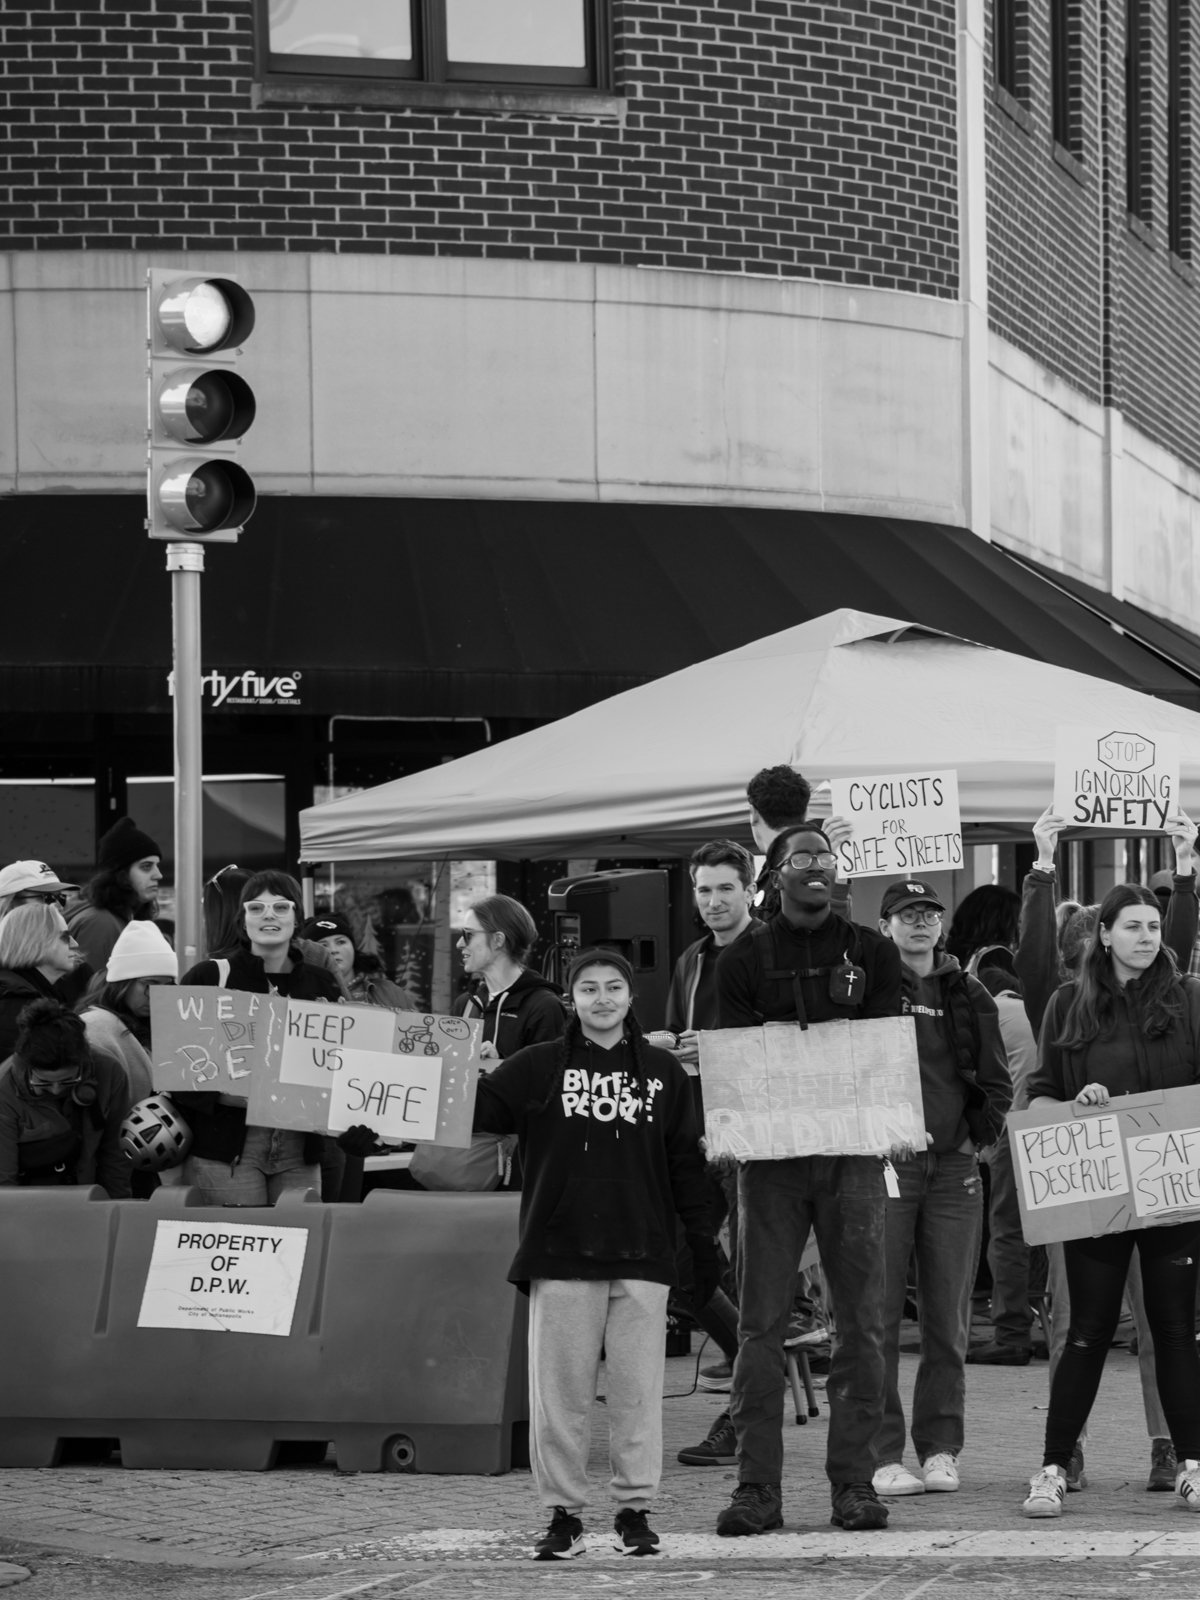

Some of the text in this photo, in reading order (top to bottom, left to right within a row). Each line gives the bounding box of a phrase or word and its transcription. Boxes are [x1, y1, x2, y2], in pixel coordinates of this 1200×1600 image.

[1104, 741, 1146, 762] STOP
[849, 777, 943, 811] CYCLISTS
[1074, 769, 1171, 799] IGNORING
[882, 818, 907, 834] FOR
[1073, 794, 1170, 829] SAFETY
[839, 833, 961, 872] SAFE STREETS
[288, 1009, 355, 1045] KEEP
[312, 1047, 344, 1071] US
[346, 1078, 427, 1124] SAFE
[1022, 1117, 1115, 1164] PEOPLE
[1029, 1155, 1122, 1205] DESERVE
[177, 1233, 283, 1254] PROPERTY
[210, 1255, 240, 1272] OF
[190, 1276, 250, 1296] D.P.W.
